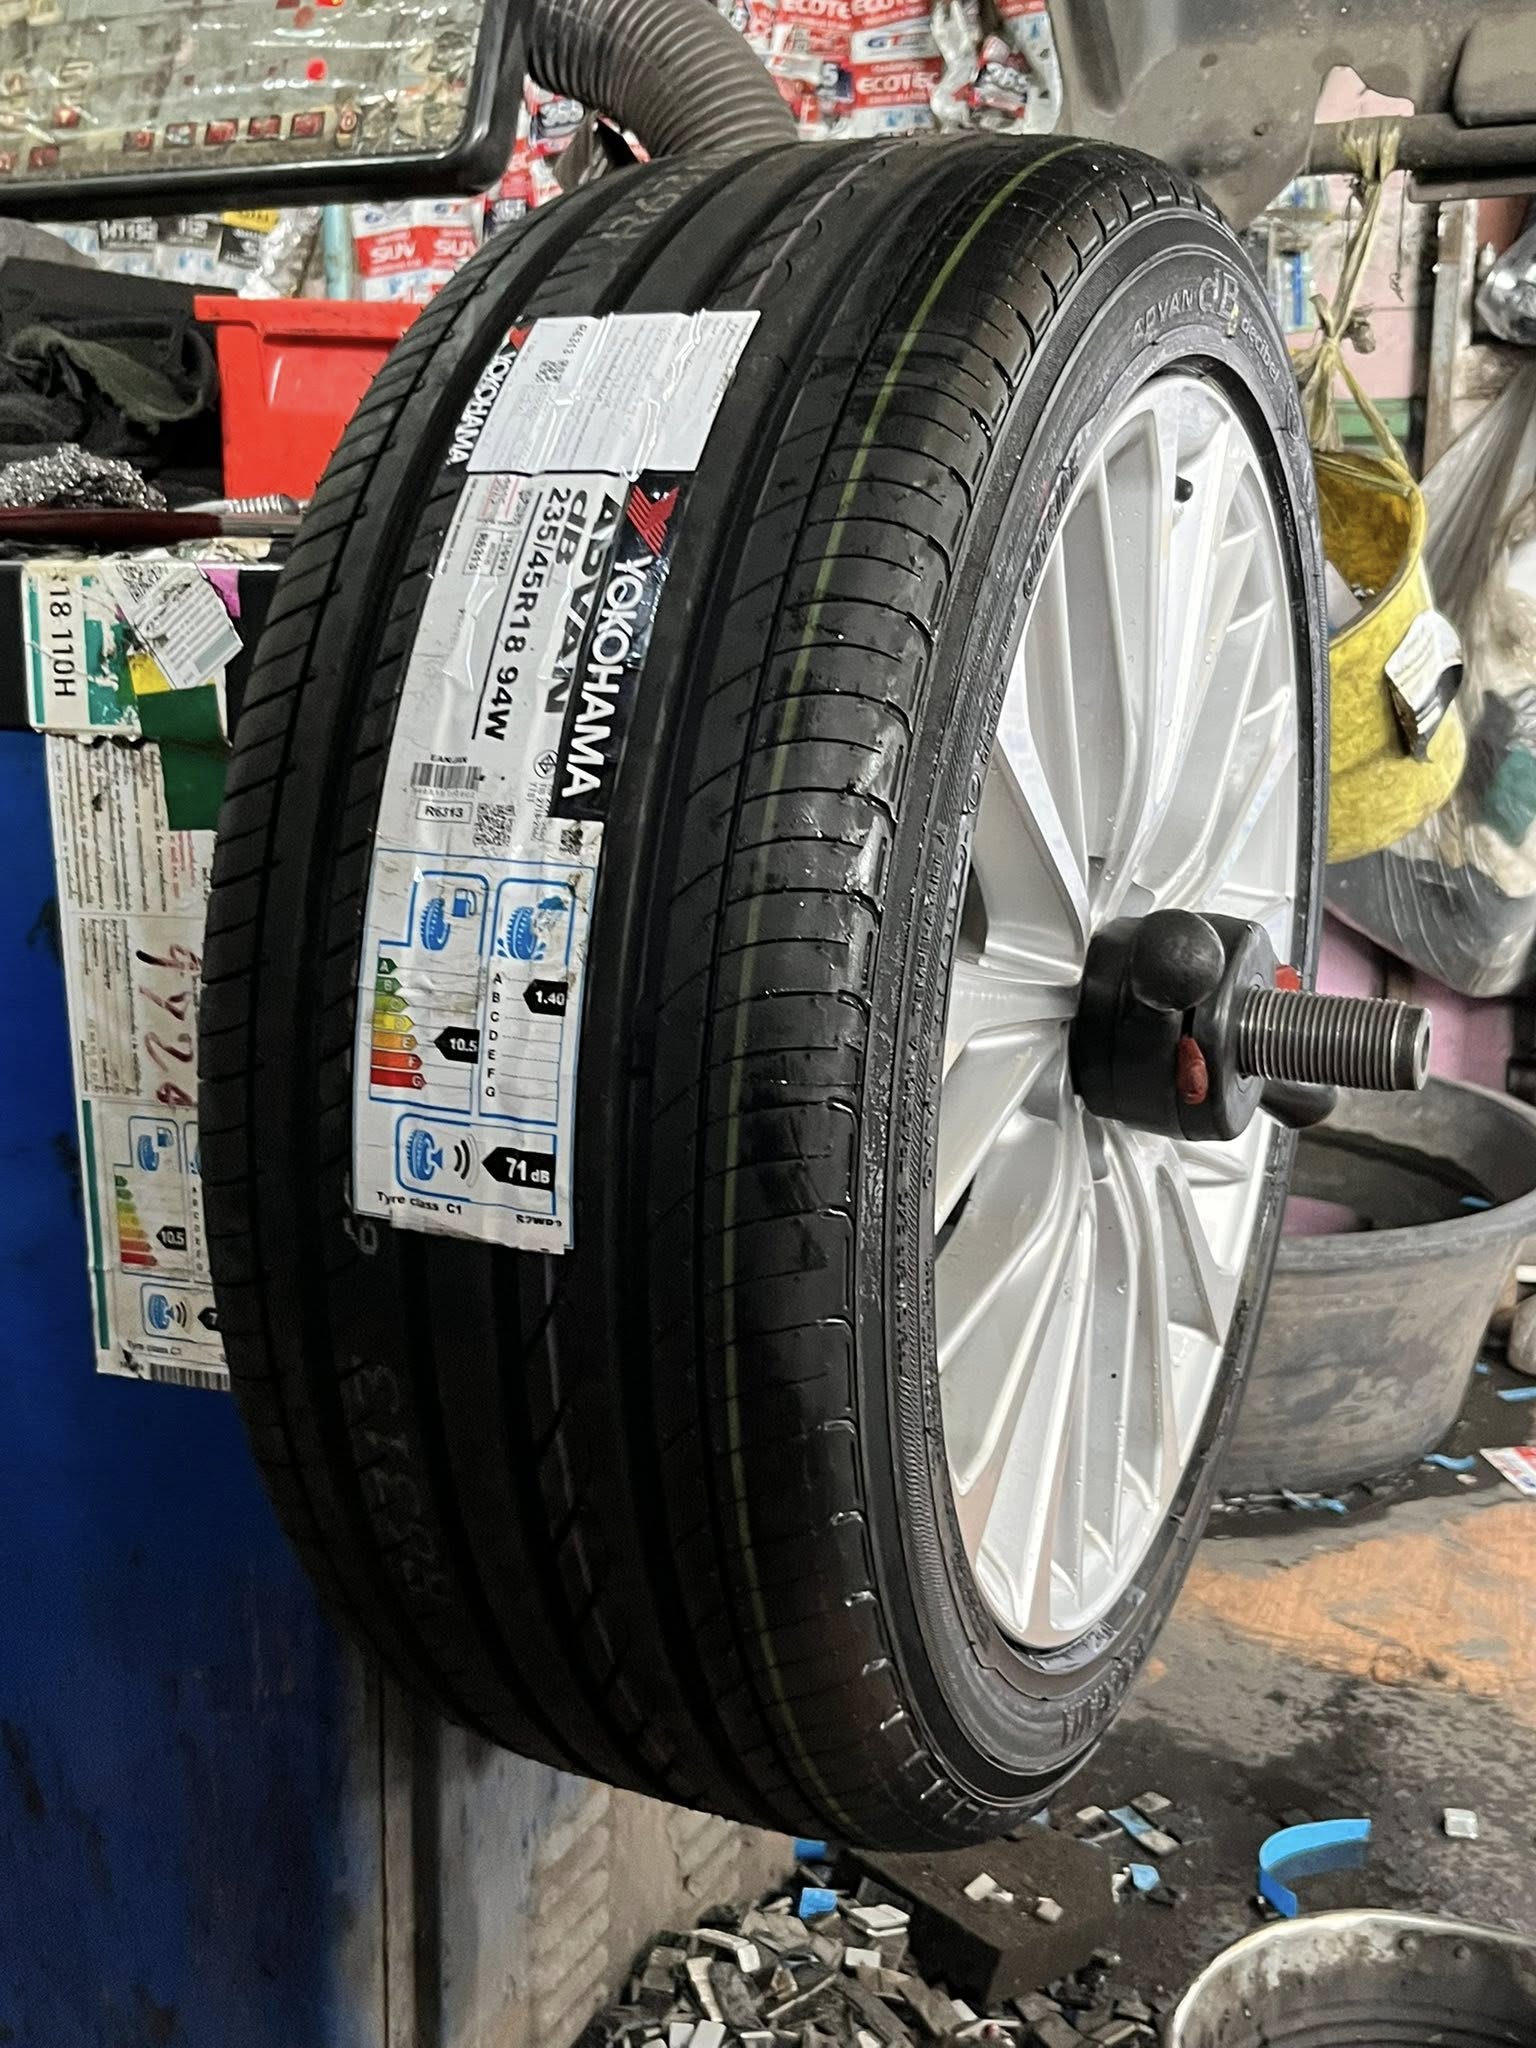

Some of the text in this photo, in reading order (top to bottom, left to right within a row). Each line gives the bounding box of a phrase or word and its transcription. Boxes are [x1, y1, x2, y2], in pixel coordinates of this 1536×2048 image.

[370, 240, 417, 264] SUV
[446, 350, 517, 466] YOKOHAMA
[555, 490, 588, 565] dB
[485, 487, 571, 740] 235/45R18 94W
[545, 491, 622, 713] ADVAN
[51, 629, 77, 697] 110H
[562, 555, 653, 797] YOKOHAMA
[493, 973, 502, 985] A
[492, 990, 566, 1006] B 1.40
[490, 1011, 500, 1022] C
[450, 1038, 479, 1052] 10.5
[489, 1029, 499, 1041] D
[487, 1049, 496, 1060] E
[487, 1067, 496, 1078] F
[485, 1086, 496, 1097] G
[505, 1157, 551, 1184] 71 dB
[377, 1191, 462, 1215] Tyre class C1
